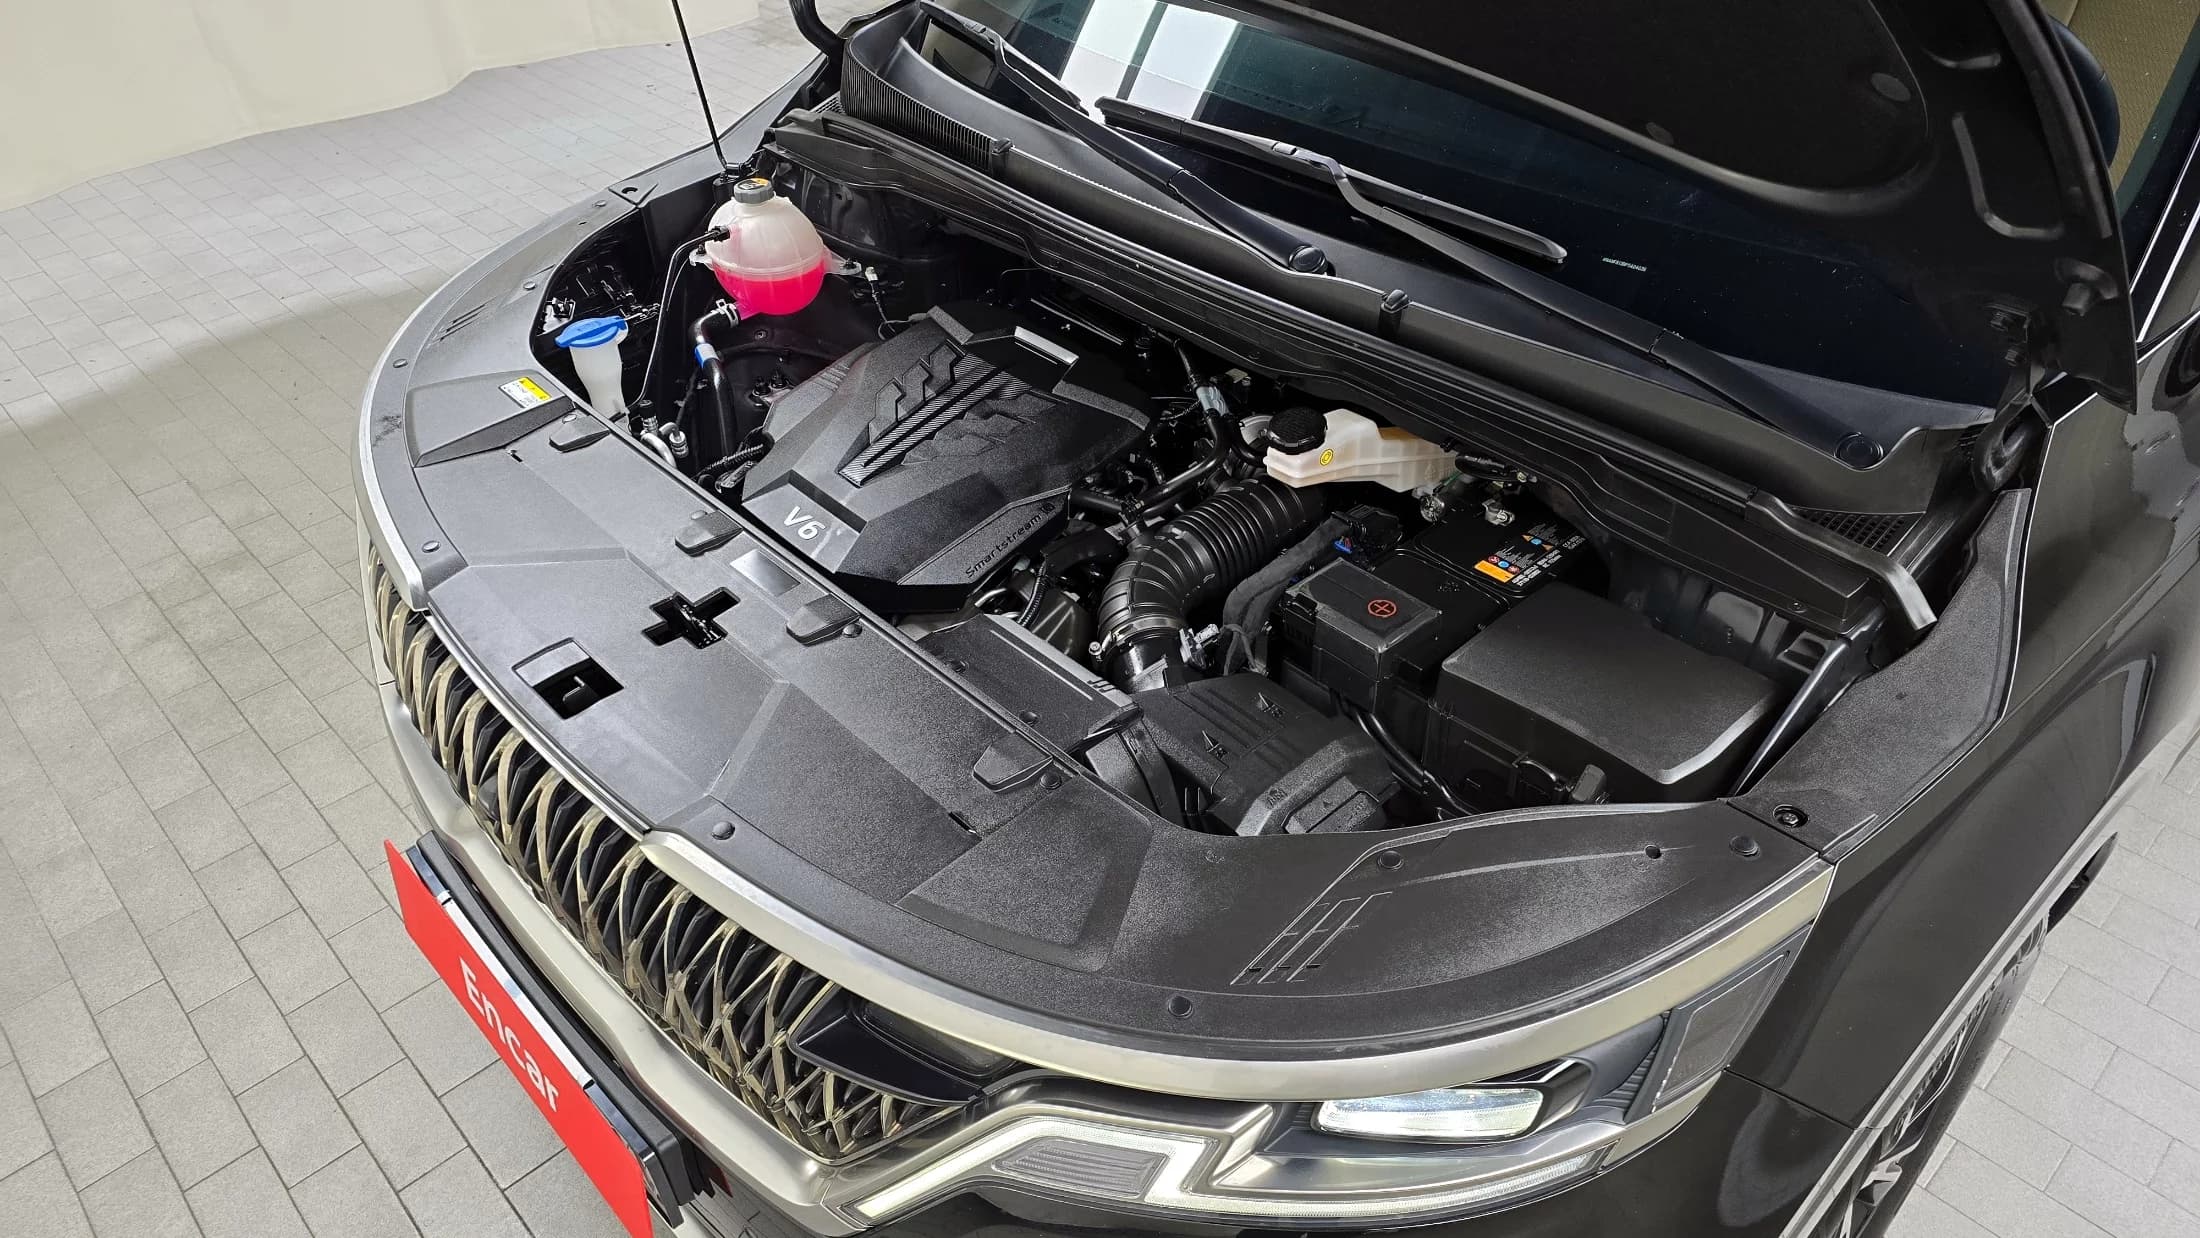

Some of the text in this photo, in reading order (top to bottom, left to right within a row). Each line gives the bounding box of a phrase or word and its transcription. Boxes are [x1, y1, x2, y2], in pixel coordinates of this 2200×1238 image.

[783, 505, 826, 540] V6
[965, 513, 1042, 579] Smartstream
[459, 956, 560, 1113] Encar
